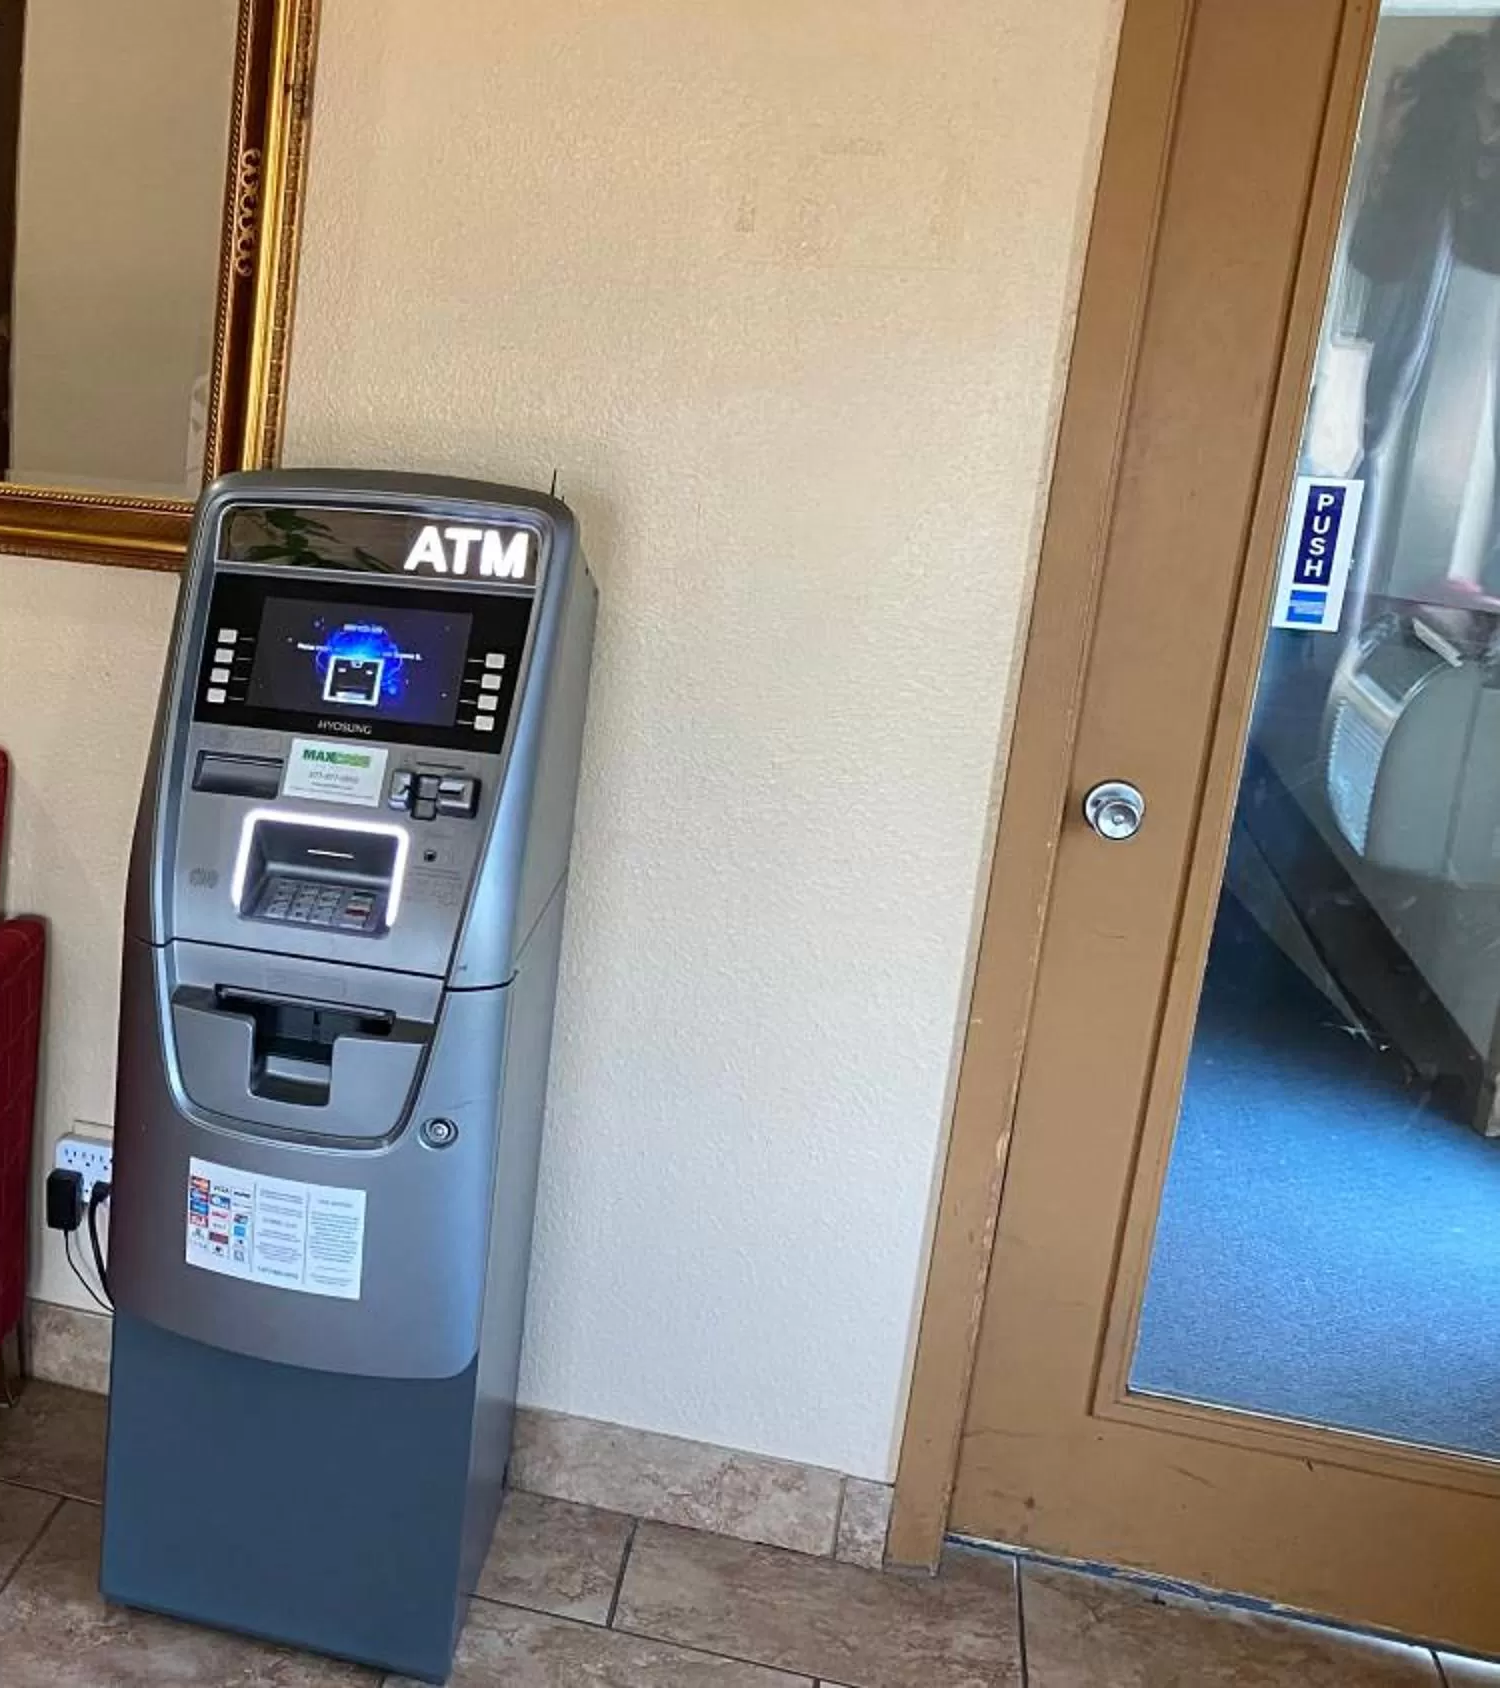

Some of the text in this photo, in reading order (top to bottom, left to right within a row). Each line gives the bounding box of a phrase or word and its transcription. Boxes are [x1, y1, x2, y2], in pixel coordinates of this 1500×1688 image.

[404, 525, 529, 580] ATM
[1303, 493, 1335, 578] PUSH
[317, 719, 373, 735] HYOSUNG
